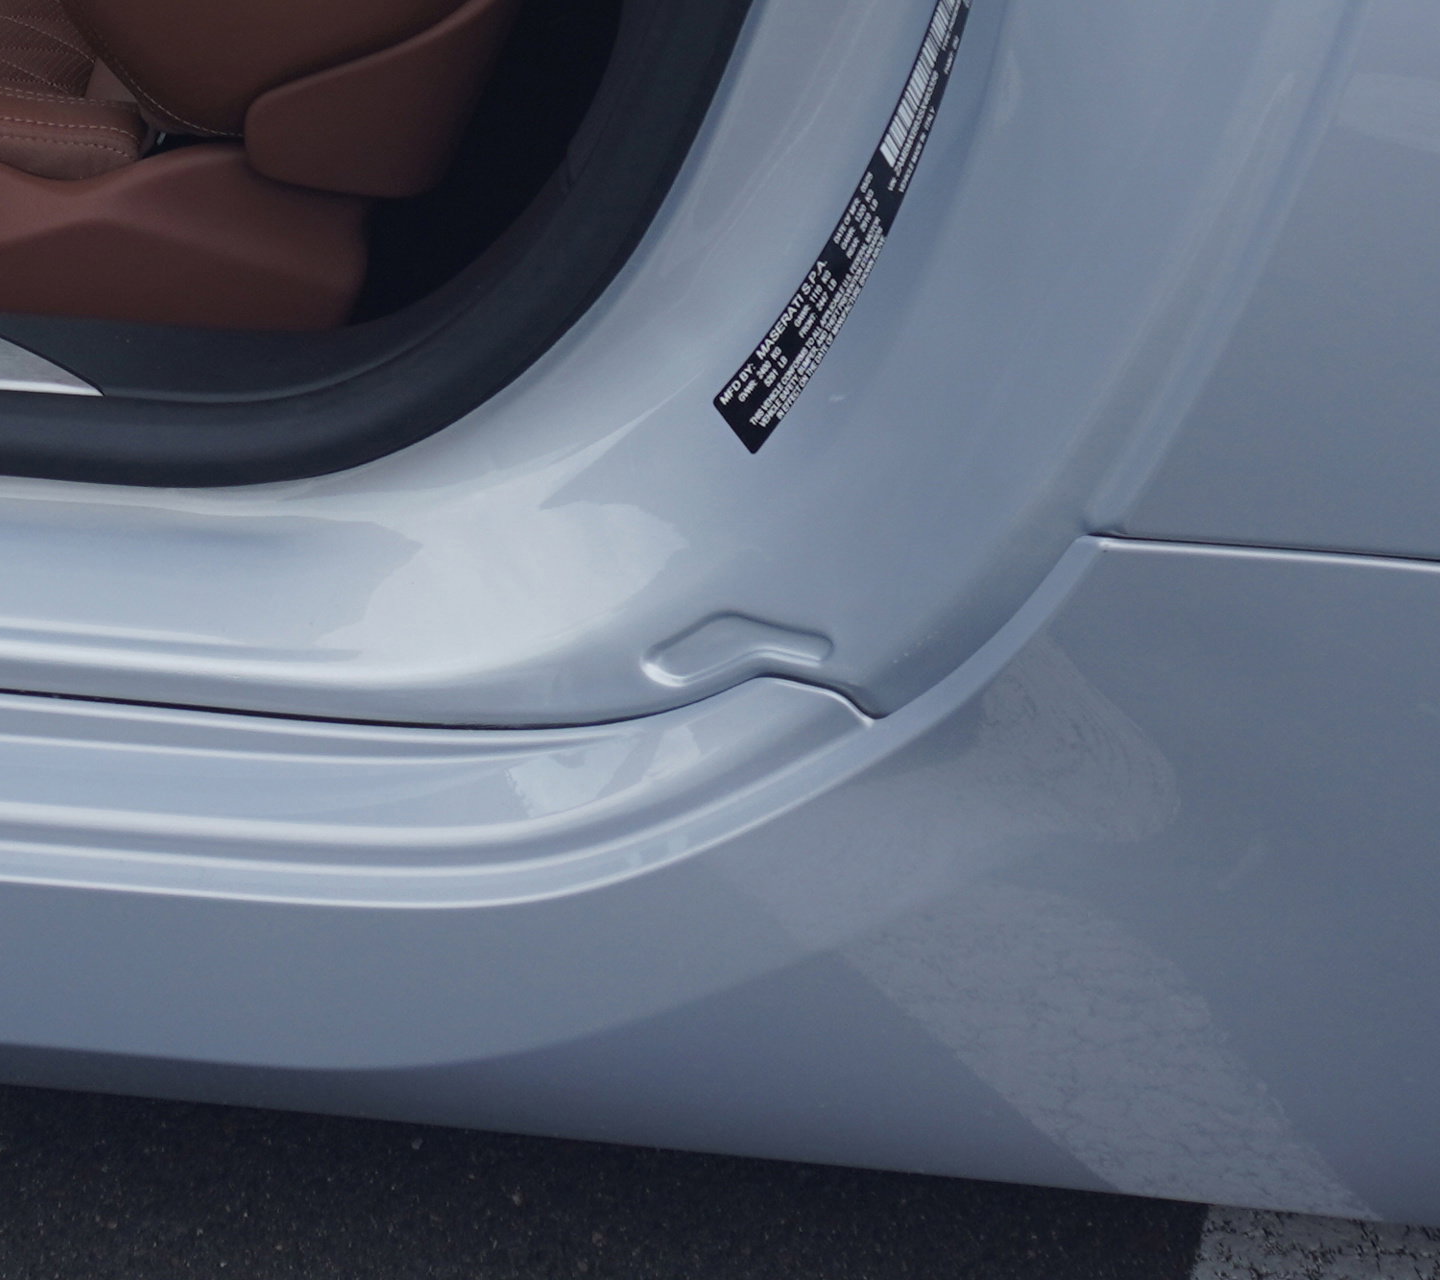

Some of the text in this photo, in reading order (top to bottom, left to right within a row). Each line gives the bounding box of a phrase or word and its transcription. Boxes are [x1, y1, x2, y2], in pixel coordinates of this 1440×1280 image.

[923, 106, 935, 130] ITALY
[869, 198, 879, 212] LB
[809, 284, 823, 303] 1110
[820, 269, 831, 284] KG
[798, 278, 837, 338] FRONT: 2447 LB
[719, 260, 827, 405] MFD BY: MASERATI S.P.A.
[749, 408, 765, 425] THIS
[761, 382, 784, 411] VEHICLE
[780, 347, 808, 385] CONFORMS
[811, 325, 823, 340] ALL
[819, 286, 845, 327] APPLICABLE
[756, 360, 772, 379] 2400
[770, 346, 782, 360] KG
[777, 355, 788, 369] LB
[758, 398, 784, 427] VEHICLE
